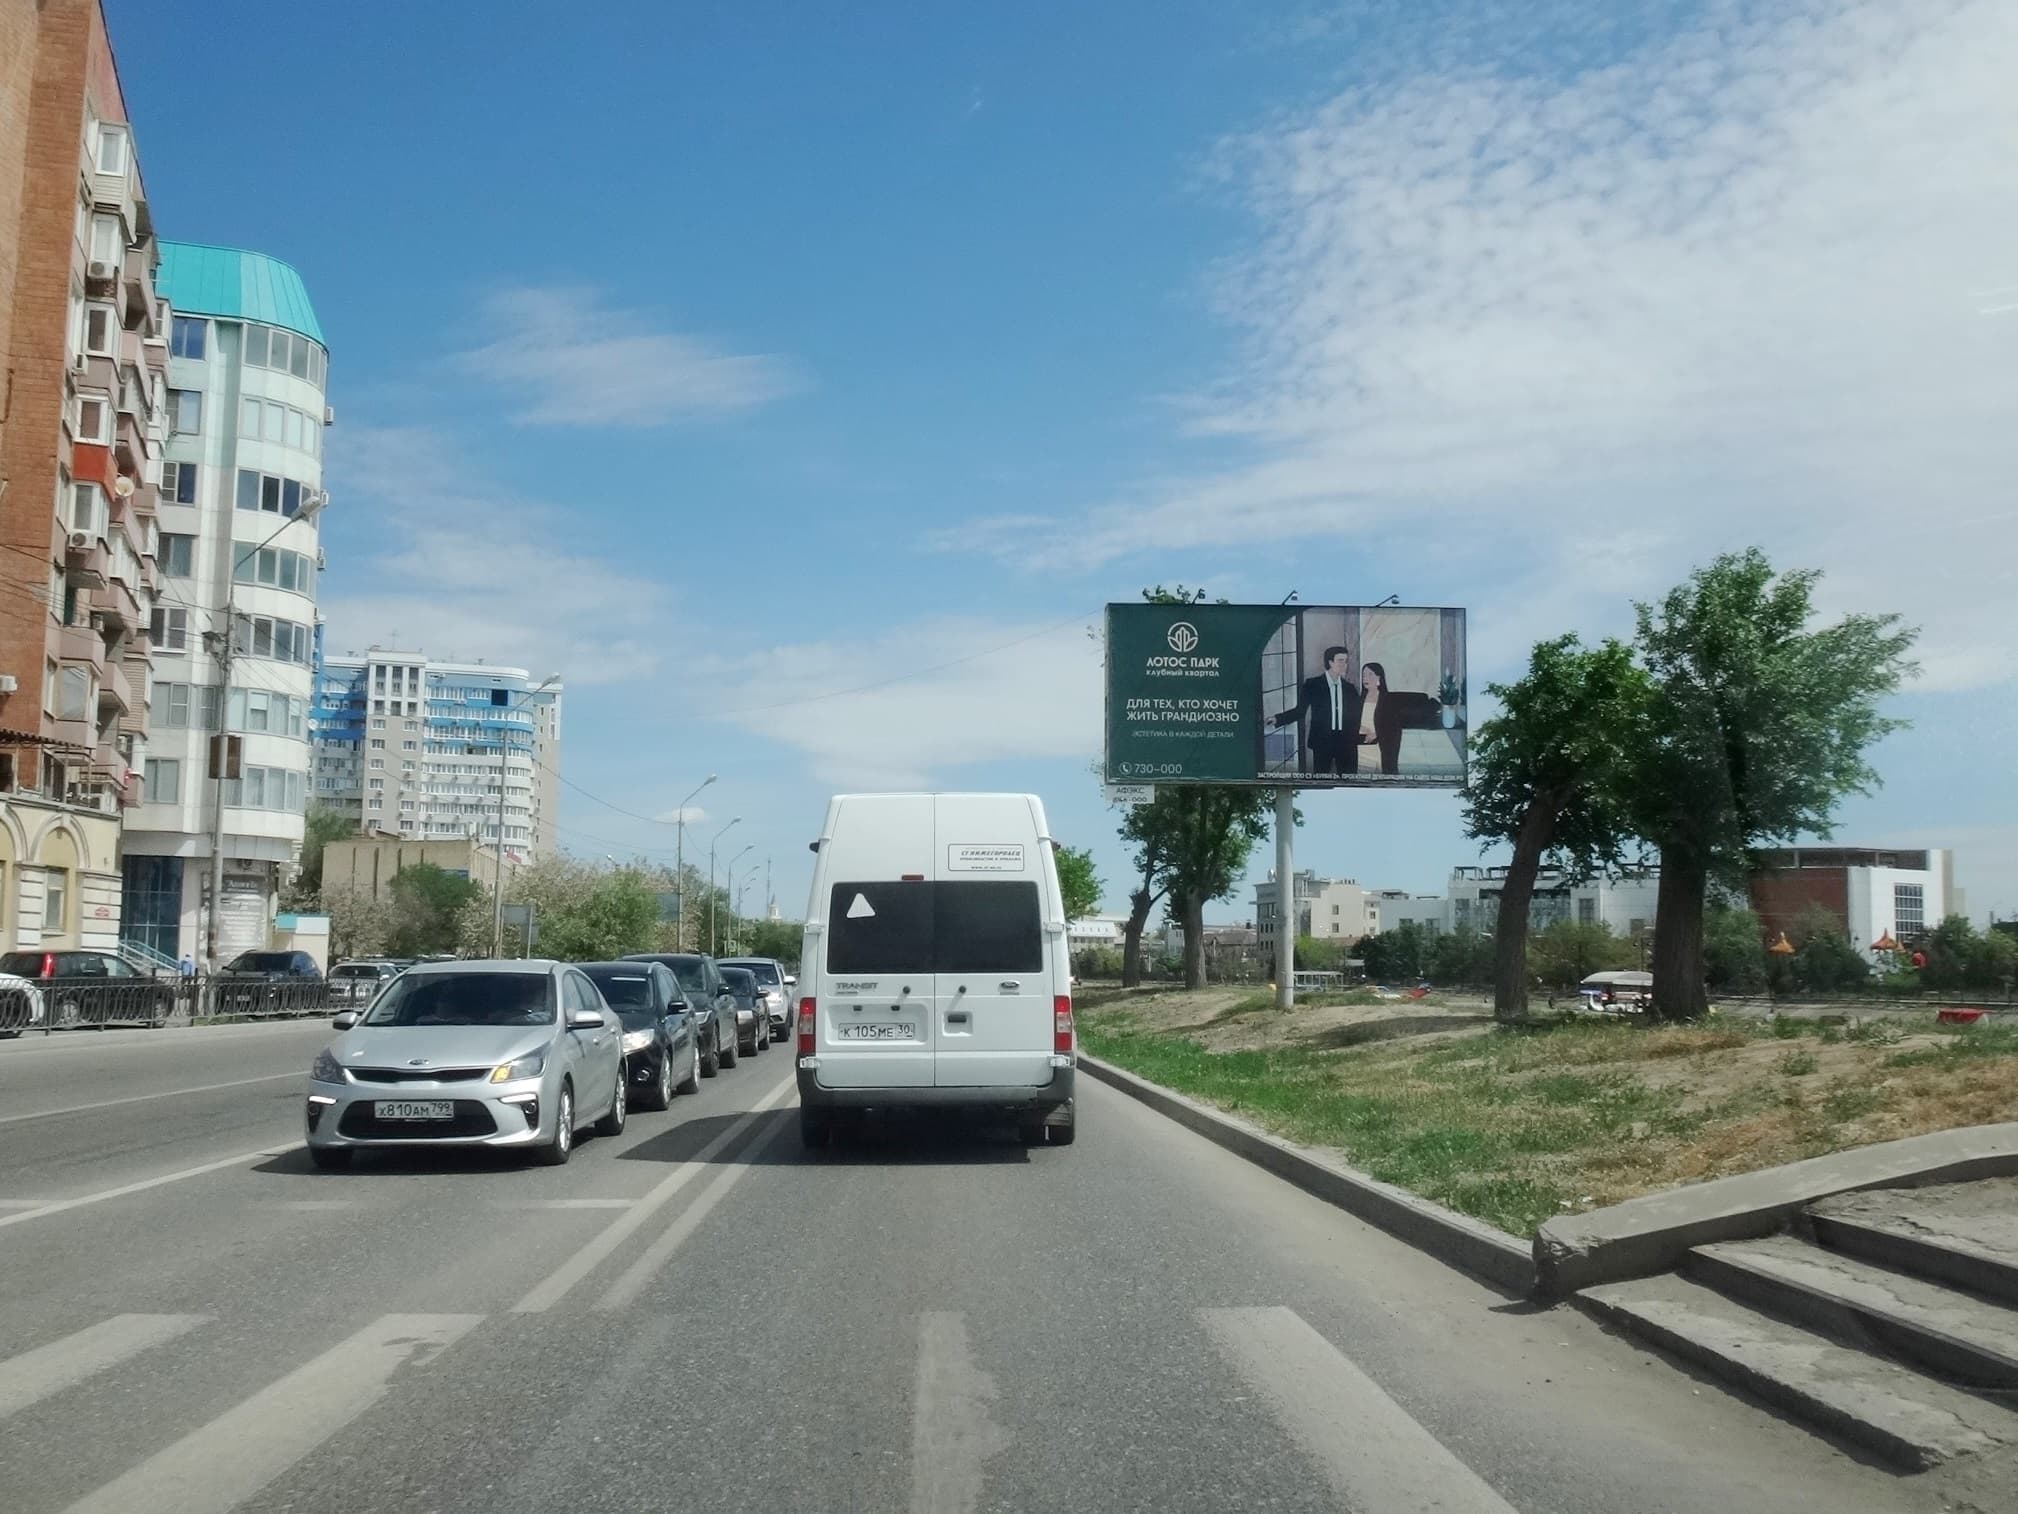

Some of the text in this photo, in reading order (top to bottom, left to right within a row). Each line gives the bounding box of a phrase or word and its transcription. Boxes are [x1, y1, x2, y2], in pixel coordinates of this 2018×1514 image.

[1146, 656, 1220, 668] ЛОТОС ПАРК
[1126, 698, 1239, 711] ДЛЯ ТЕХ, КТО ХОЧЕТ
[1126, 710, 1240, 723] ЖИТЬ ГРАНДИОЗНО
[1134, 763, 1183, 774] 730-000
